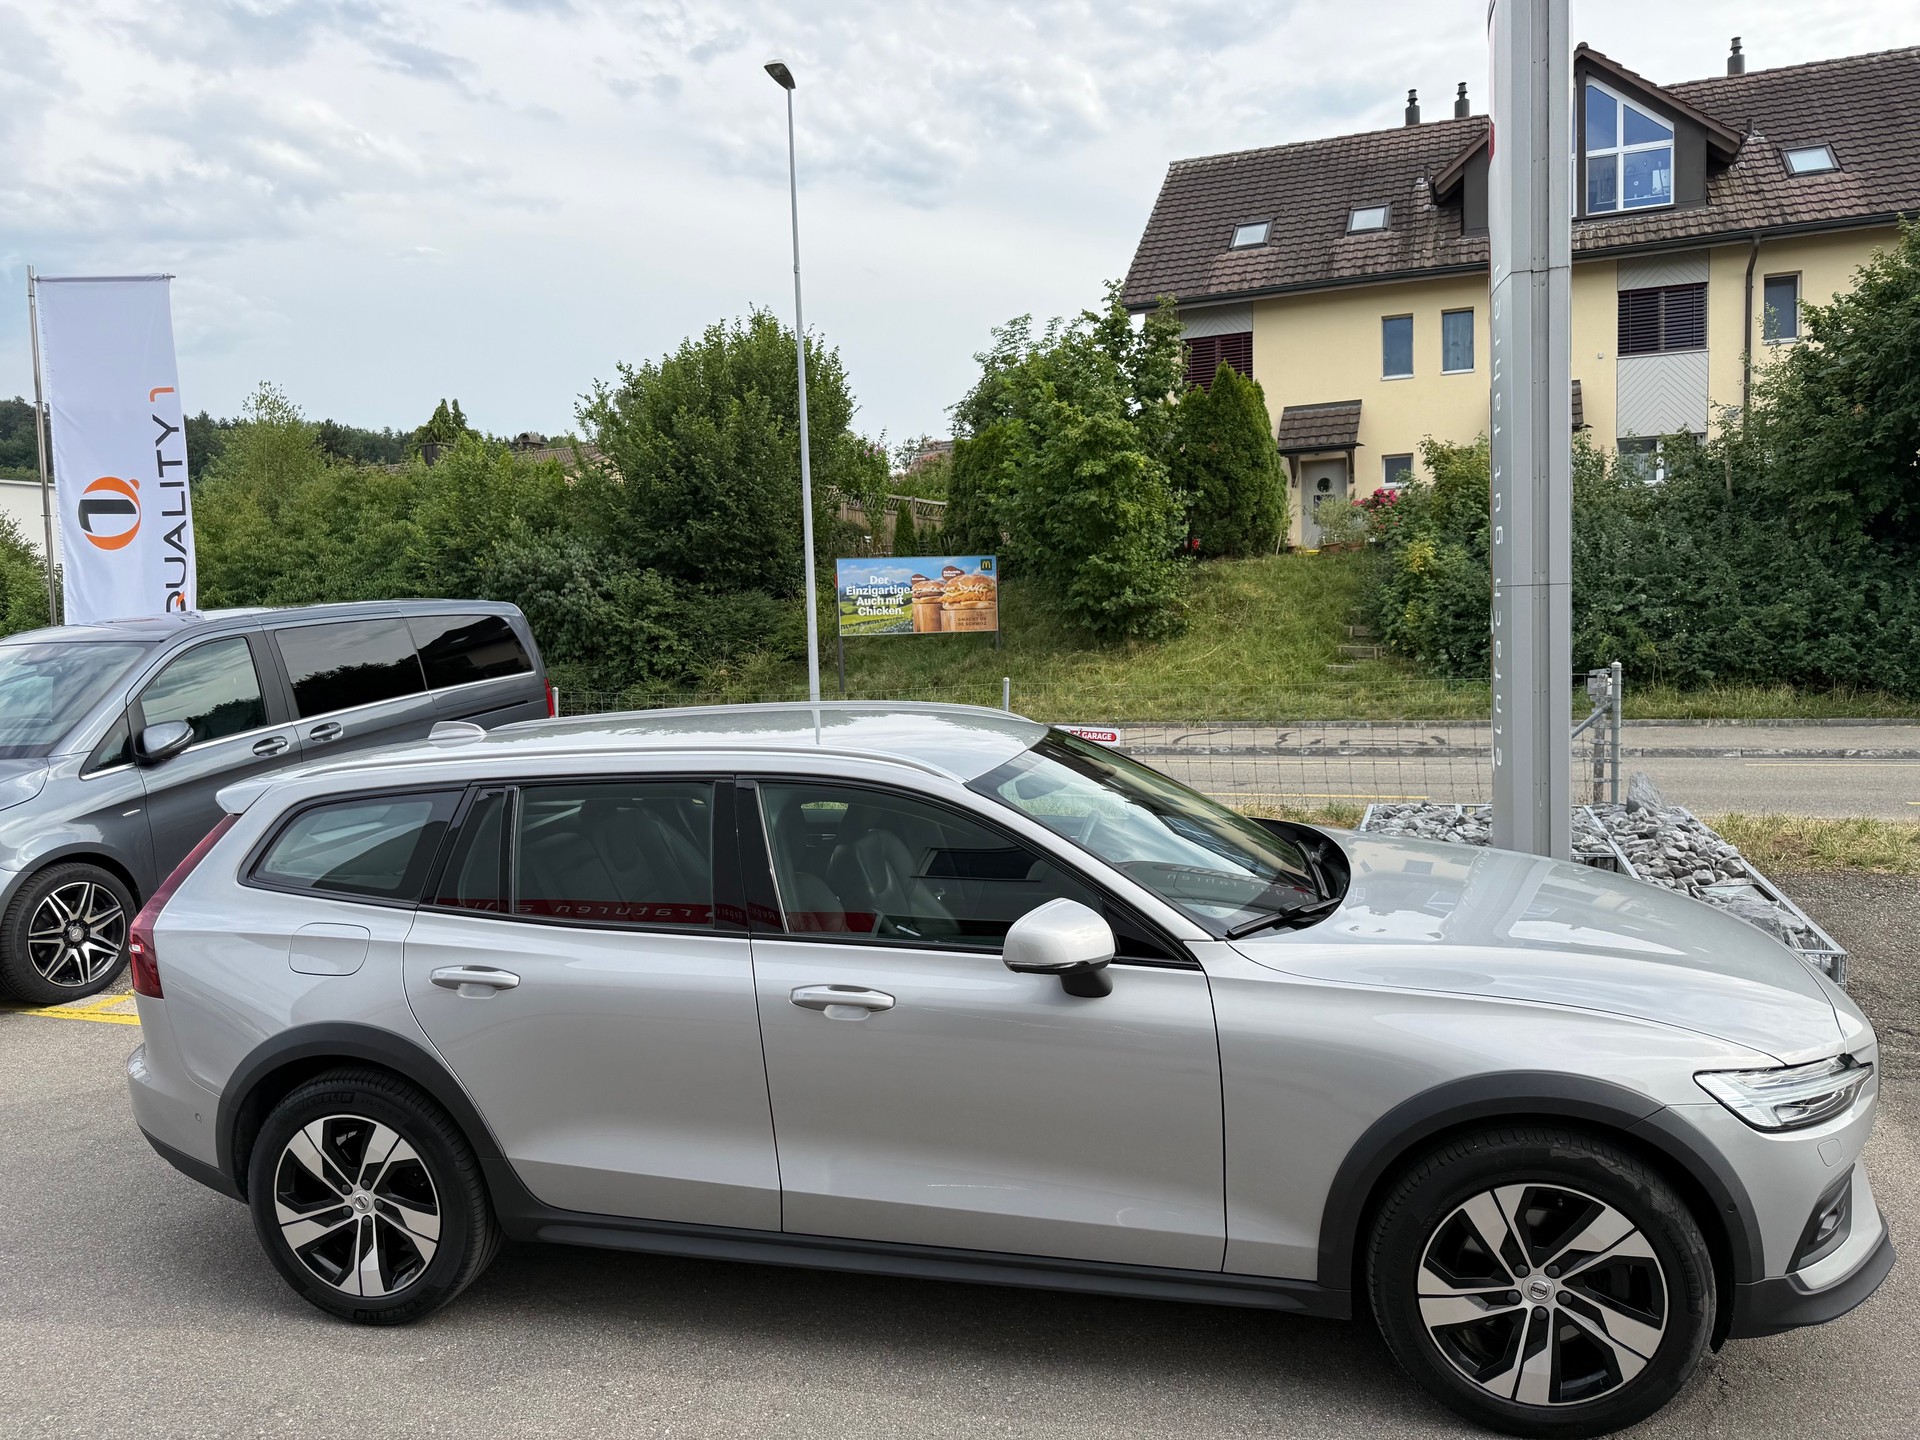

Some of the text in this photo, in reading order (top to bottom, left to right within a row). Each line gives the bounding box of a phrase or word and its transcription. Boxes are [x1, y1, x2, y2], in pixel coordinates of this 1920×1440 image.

[1493, 264, 1503, 767] einfach gut fahren
[869, 575, 889, 585] Der
[846, 584, 913, 597] Einzigartige.
[856, 595, 904, 606] Auch mit
[857, 606, 905, 616] Chicken.
[1081, 731, 1112, 740] GARAGE
